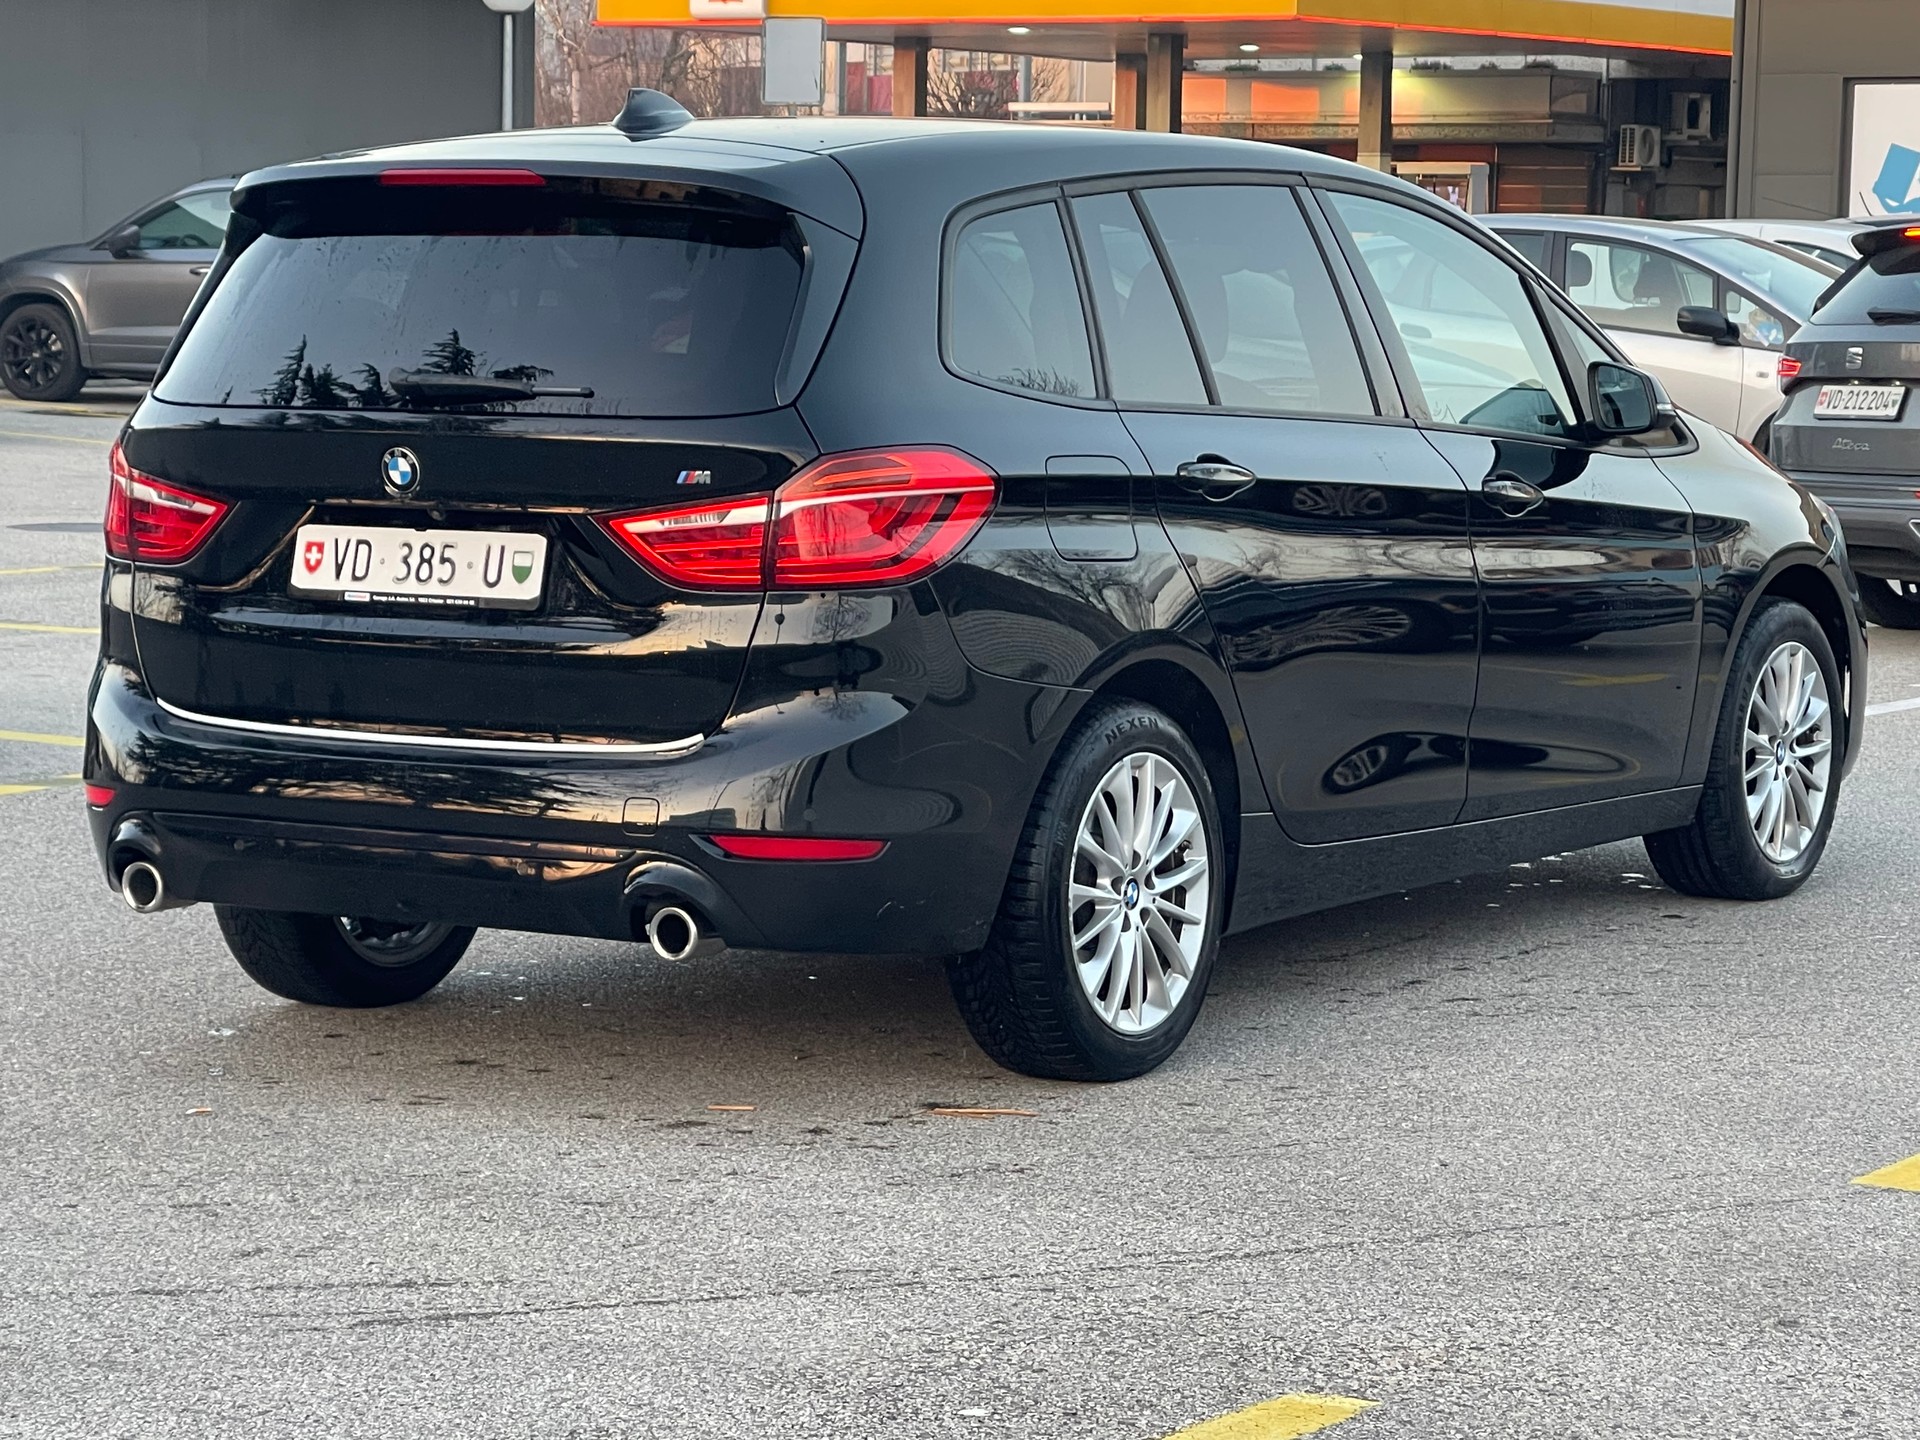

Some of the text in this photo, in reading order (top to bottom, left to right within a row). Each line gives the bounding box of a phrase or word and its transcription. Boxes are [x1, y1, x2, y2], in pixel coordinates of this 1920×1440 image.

[334, 537, 506, 589] VD 385 U
[1103, 716, 1160, 745] NEXEN
